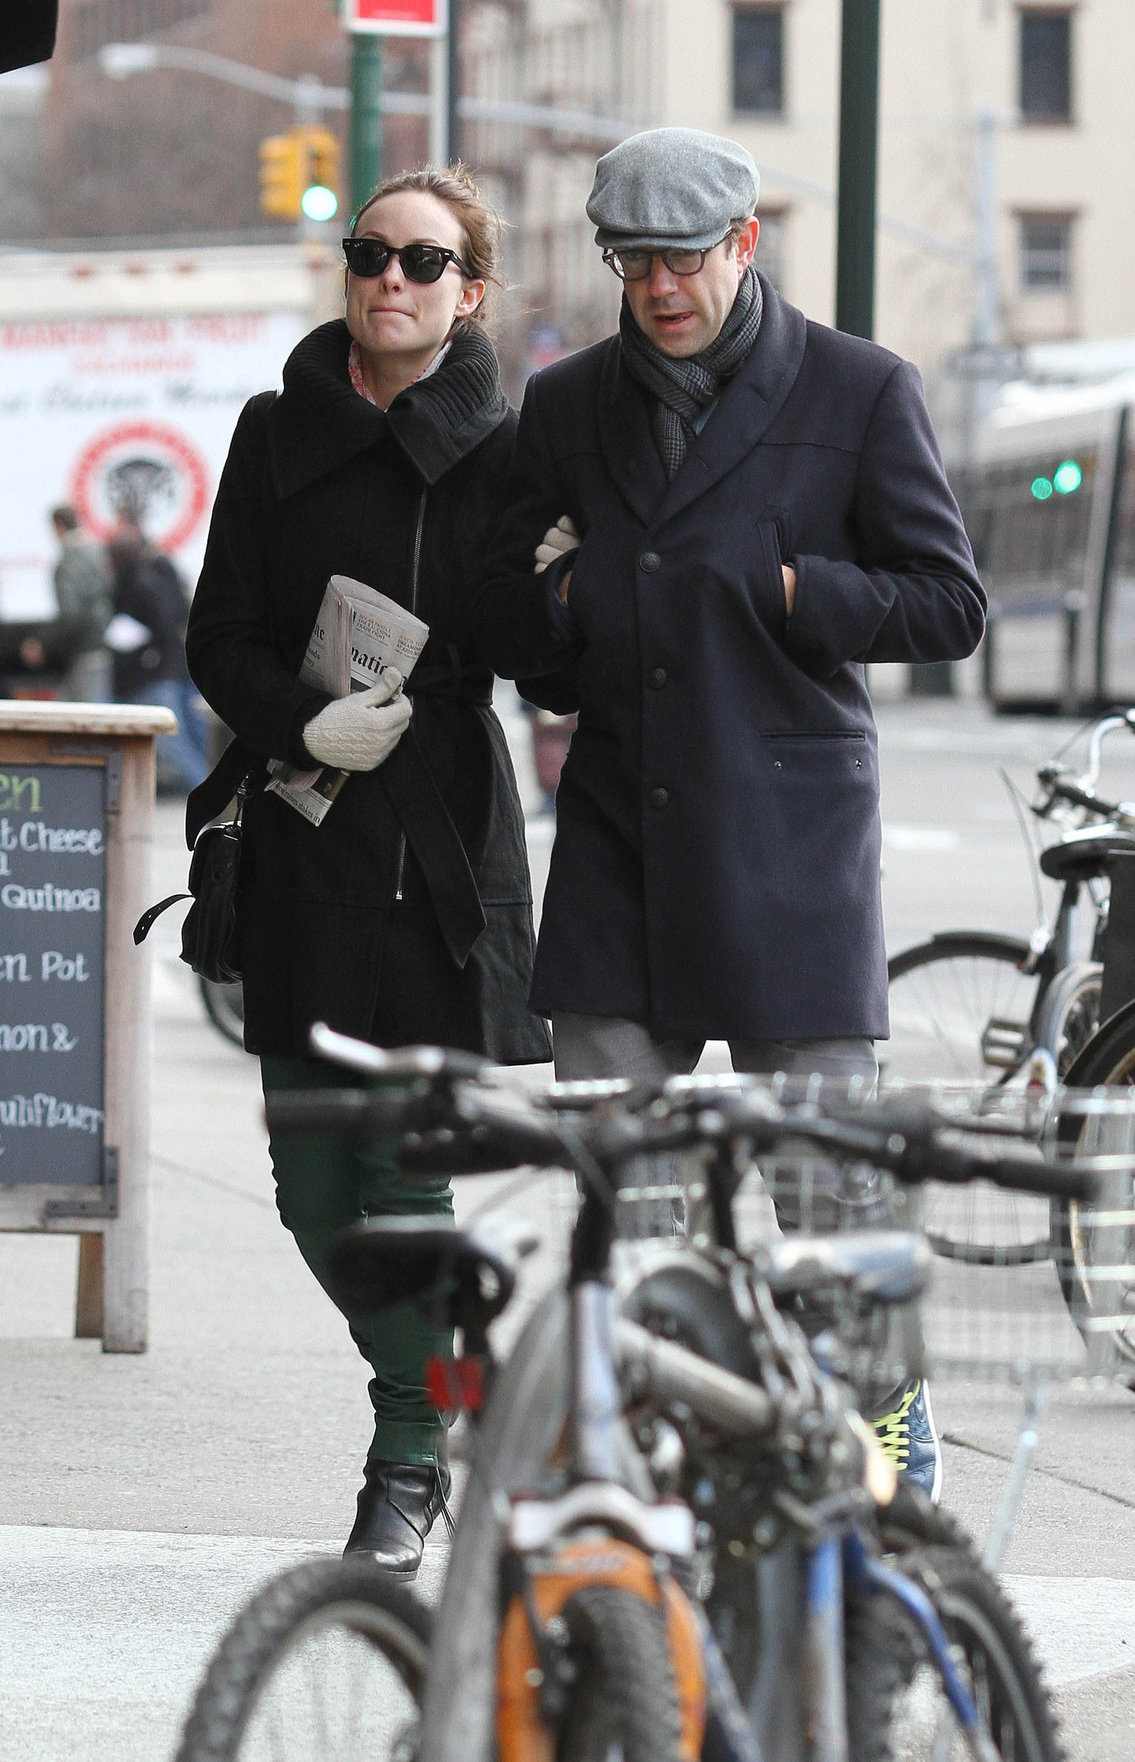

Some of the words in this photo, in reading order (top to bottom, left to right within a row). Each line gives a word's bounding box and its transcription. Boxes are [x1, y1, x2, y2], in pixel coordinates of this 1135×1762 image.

[20, 821, 104, 856] Cheese
[1, 883, 101, 912] Quinoa
[41, 950, 91, 982] Pot
